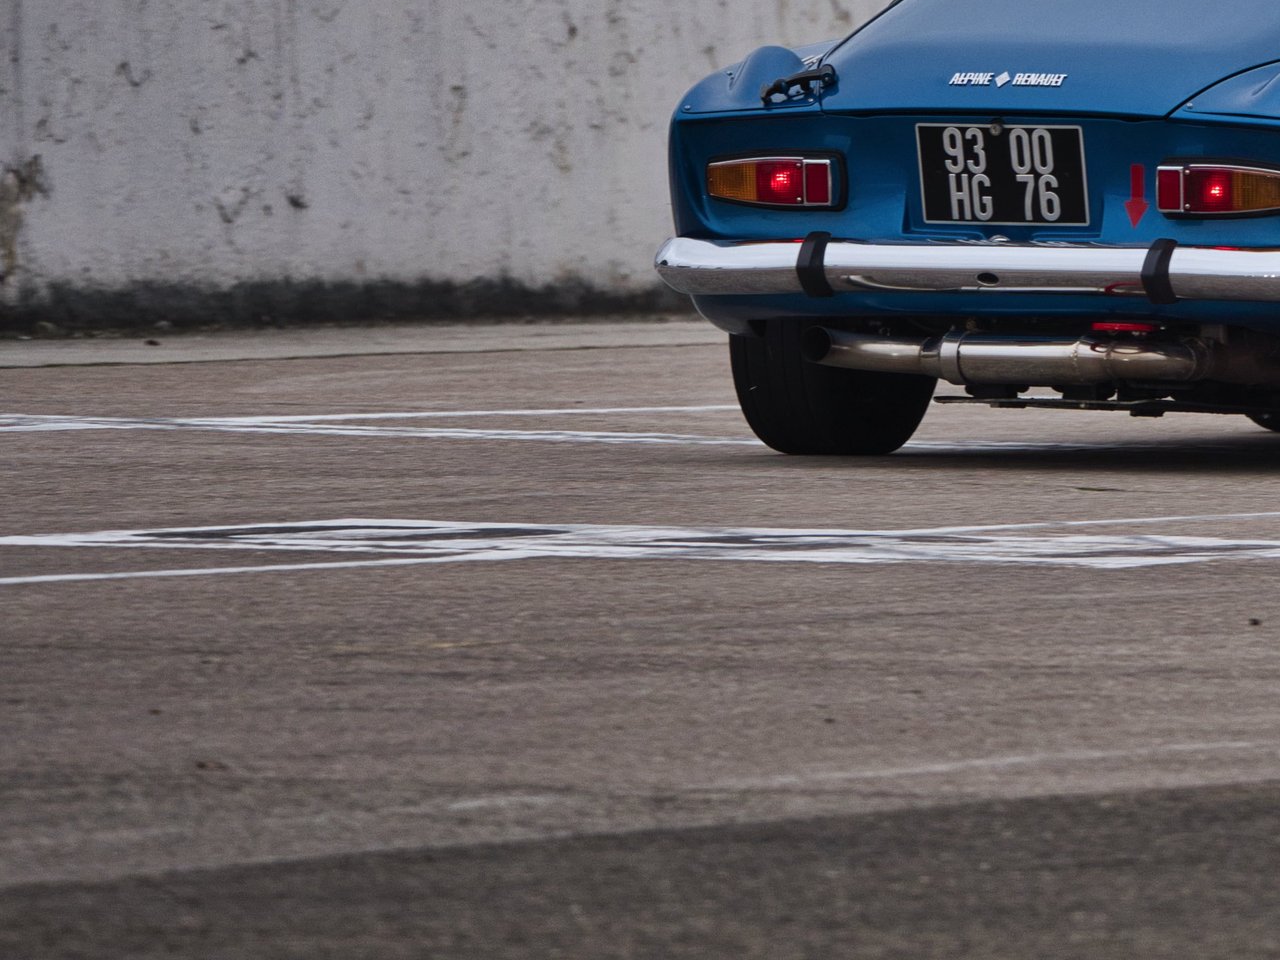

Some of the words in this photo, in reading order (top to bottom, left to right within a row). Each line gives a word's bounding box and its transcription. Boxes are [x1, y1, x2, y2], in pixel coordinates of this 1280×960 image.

[949, 72, 994, 85] ALPINE
[1012, 73, 1067, 86] RENAULT
[942, 127, 987, 174] 93
[1009, 128, 1054, 174] 00
[949, 173, 993, 221] HG
[1016, 174, 1061, 221] 76
